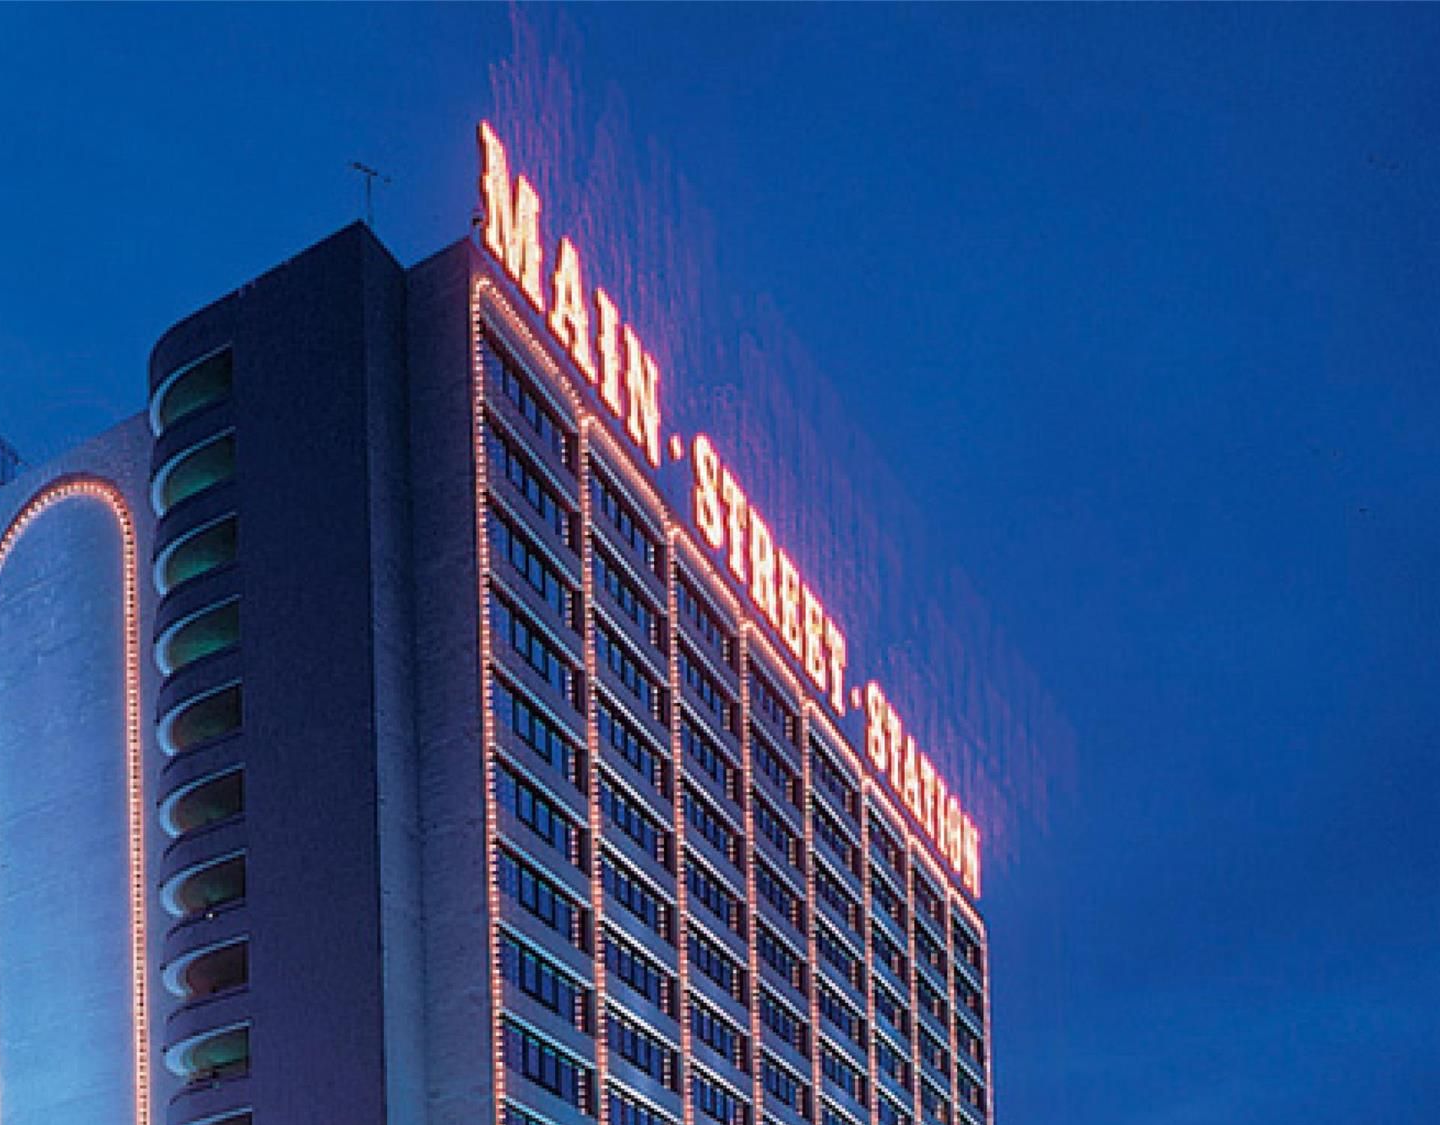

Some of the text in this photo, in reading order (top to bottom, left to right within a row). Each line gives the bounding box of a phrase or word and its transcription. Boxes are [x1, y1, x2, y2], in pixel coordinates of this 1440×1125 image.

[479, 120, 982, 896] MAIN STREET STATION
